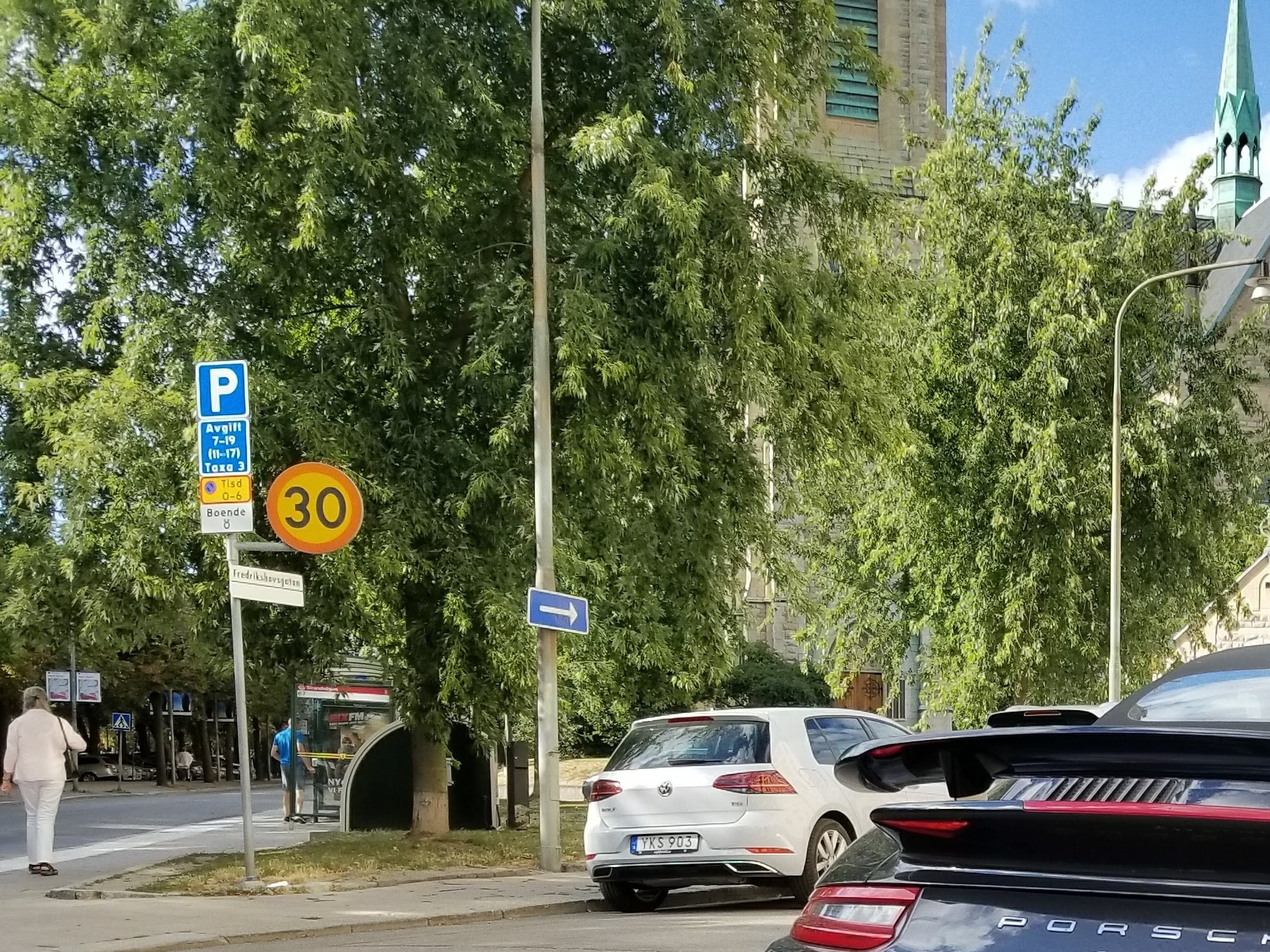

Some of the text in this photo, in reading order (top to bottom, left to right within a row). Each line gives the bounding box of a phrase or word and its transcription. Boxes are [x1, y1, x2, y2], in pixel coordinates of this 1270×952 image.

[209, 367, 239, 413] P
[205, 422, 242, 435] Avgift
[211, 435, 236, 446] 7-19
[208, 447, 241, 460] (11-17)
[204, 461, 245, 473] Taxa 3
[221, 478, 242, 488] Tisd
[222, 491, 243, 501] 0-6
[206, 508, 246, 518] Boende
[284, 486, 347, 529] 30
[223, 518, 231, 529] Ö
[641, 835, 692, 849] YKS 903
